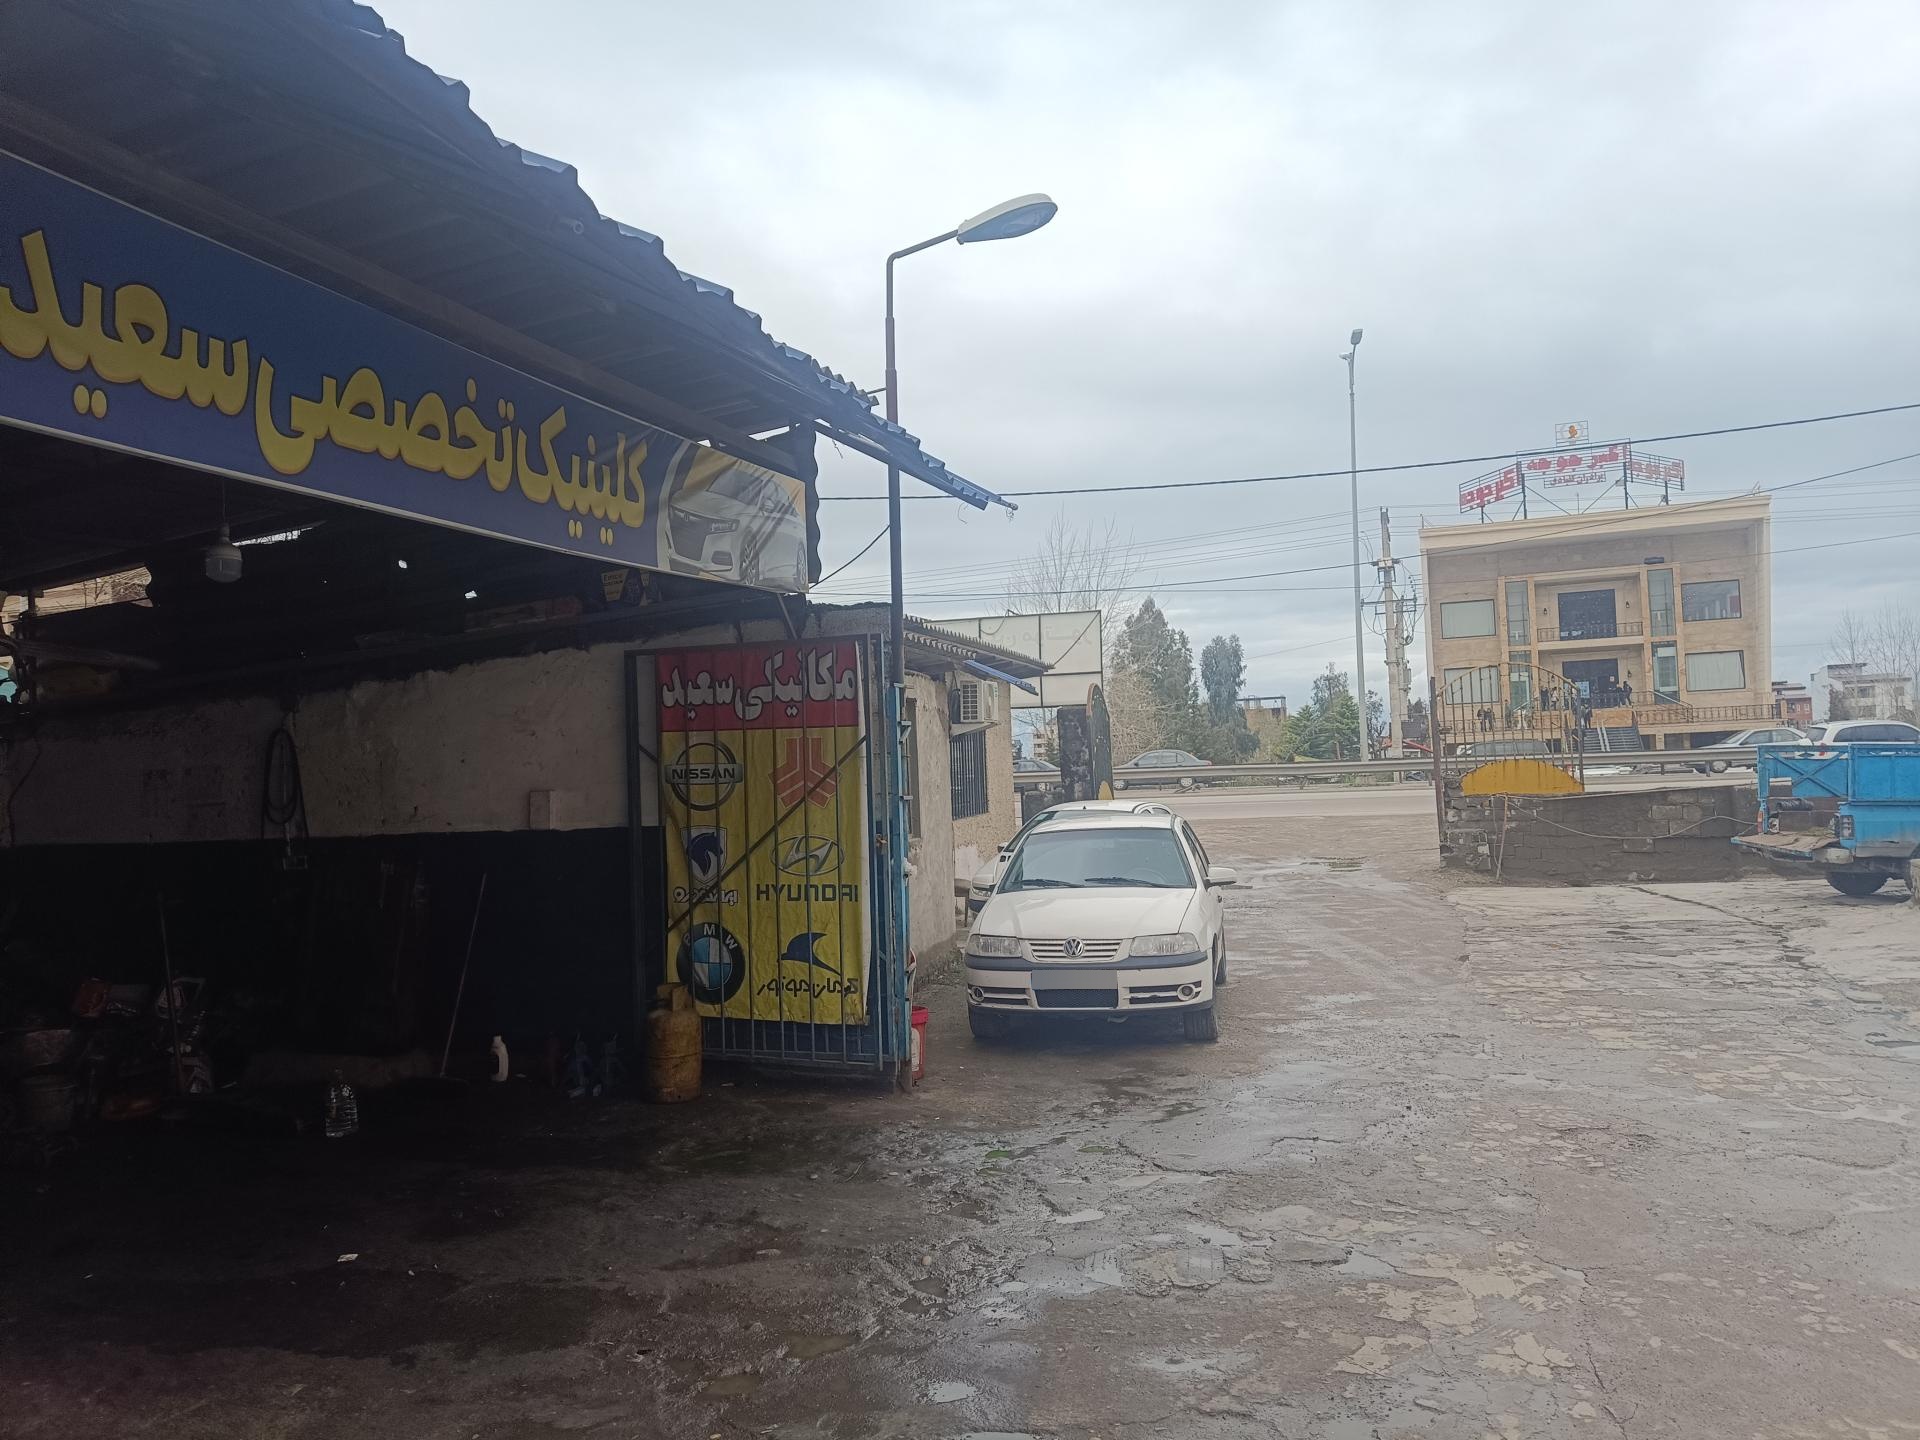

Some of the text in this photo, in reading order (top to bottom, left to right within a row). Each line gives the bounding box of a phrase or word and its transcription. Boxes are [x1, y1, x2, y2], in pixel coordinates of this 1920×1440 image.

[0, 229, 648, 546] کلینیک تخصصی سعید
[662, 648, 856, 721] مکانیکی سعید
[671, 766, 736, 780] NISSAN
[756, 883, 859, 903] HYUNDAI
